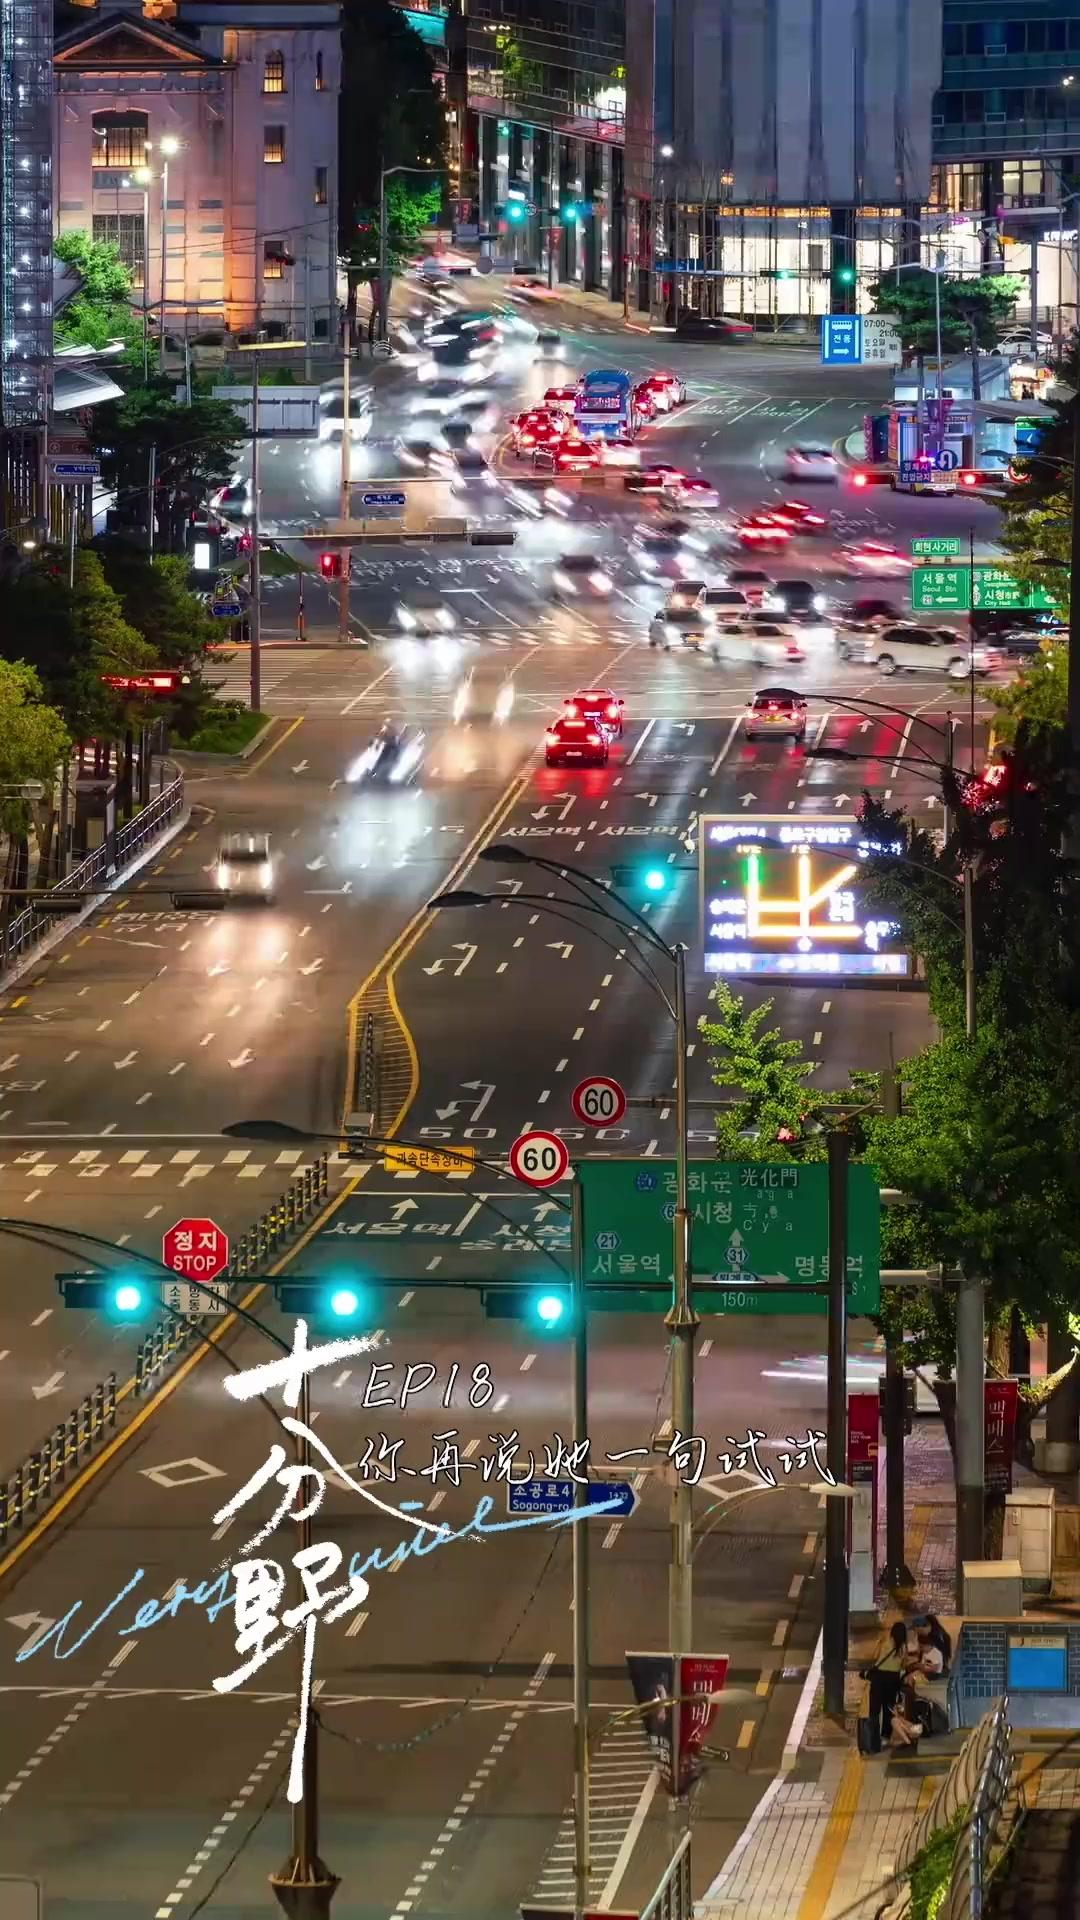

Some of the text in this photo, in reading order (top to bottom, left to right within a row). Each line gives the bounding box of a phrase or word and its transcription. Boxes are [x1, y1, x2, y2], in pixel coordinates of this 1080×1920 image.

[922, 572, 957, 584] 서울역
[584, 1089, 614, 1116] 60
[420, 1127, 497, 1138] 50
[523, 1148, 556, 1171] 60
[741, 1168, 798, 1187] 光化門
[173, 1229, 217, 1251] 정지
[600, 1233, 616, 1249] 21
[173, 1254, 217, 1272] STOP
[729, 1248, 743, 1261] 31
[592, 1254, 661, 1276] 서울역
[513, 1500, 570, 1512] Sogong-ro
